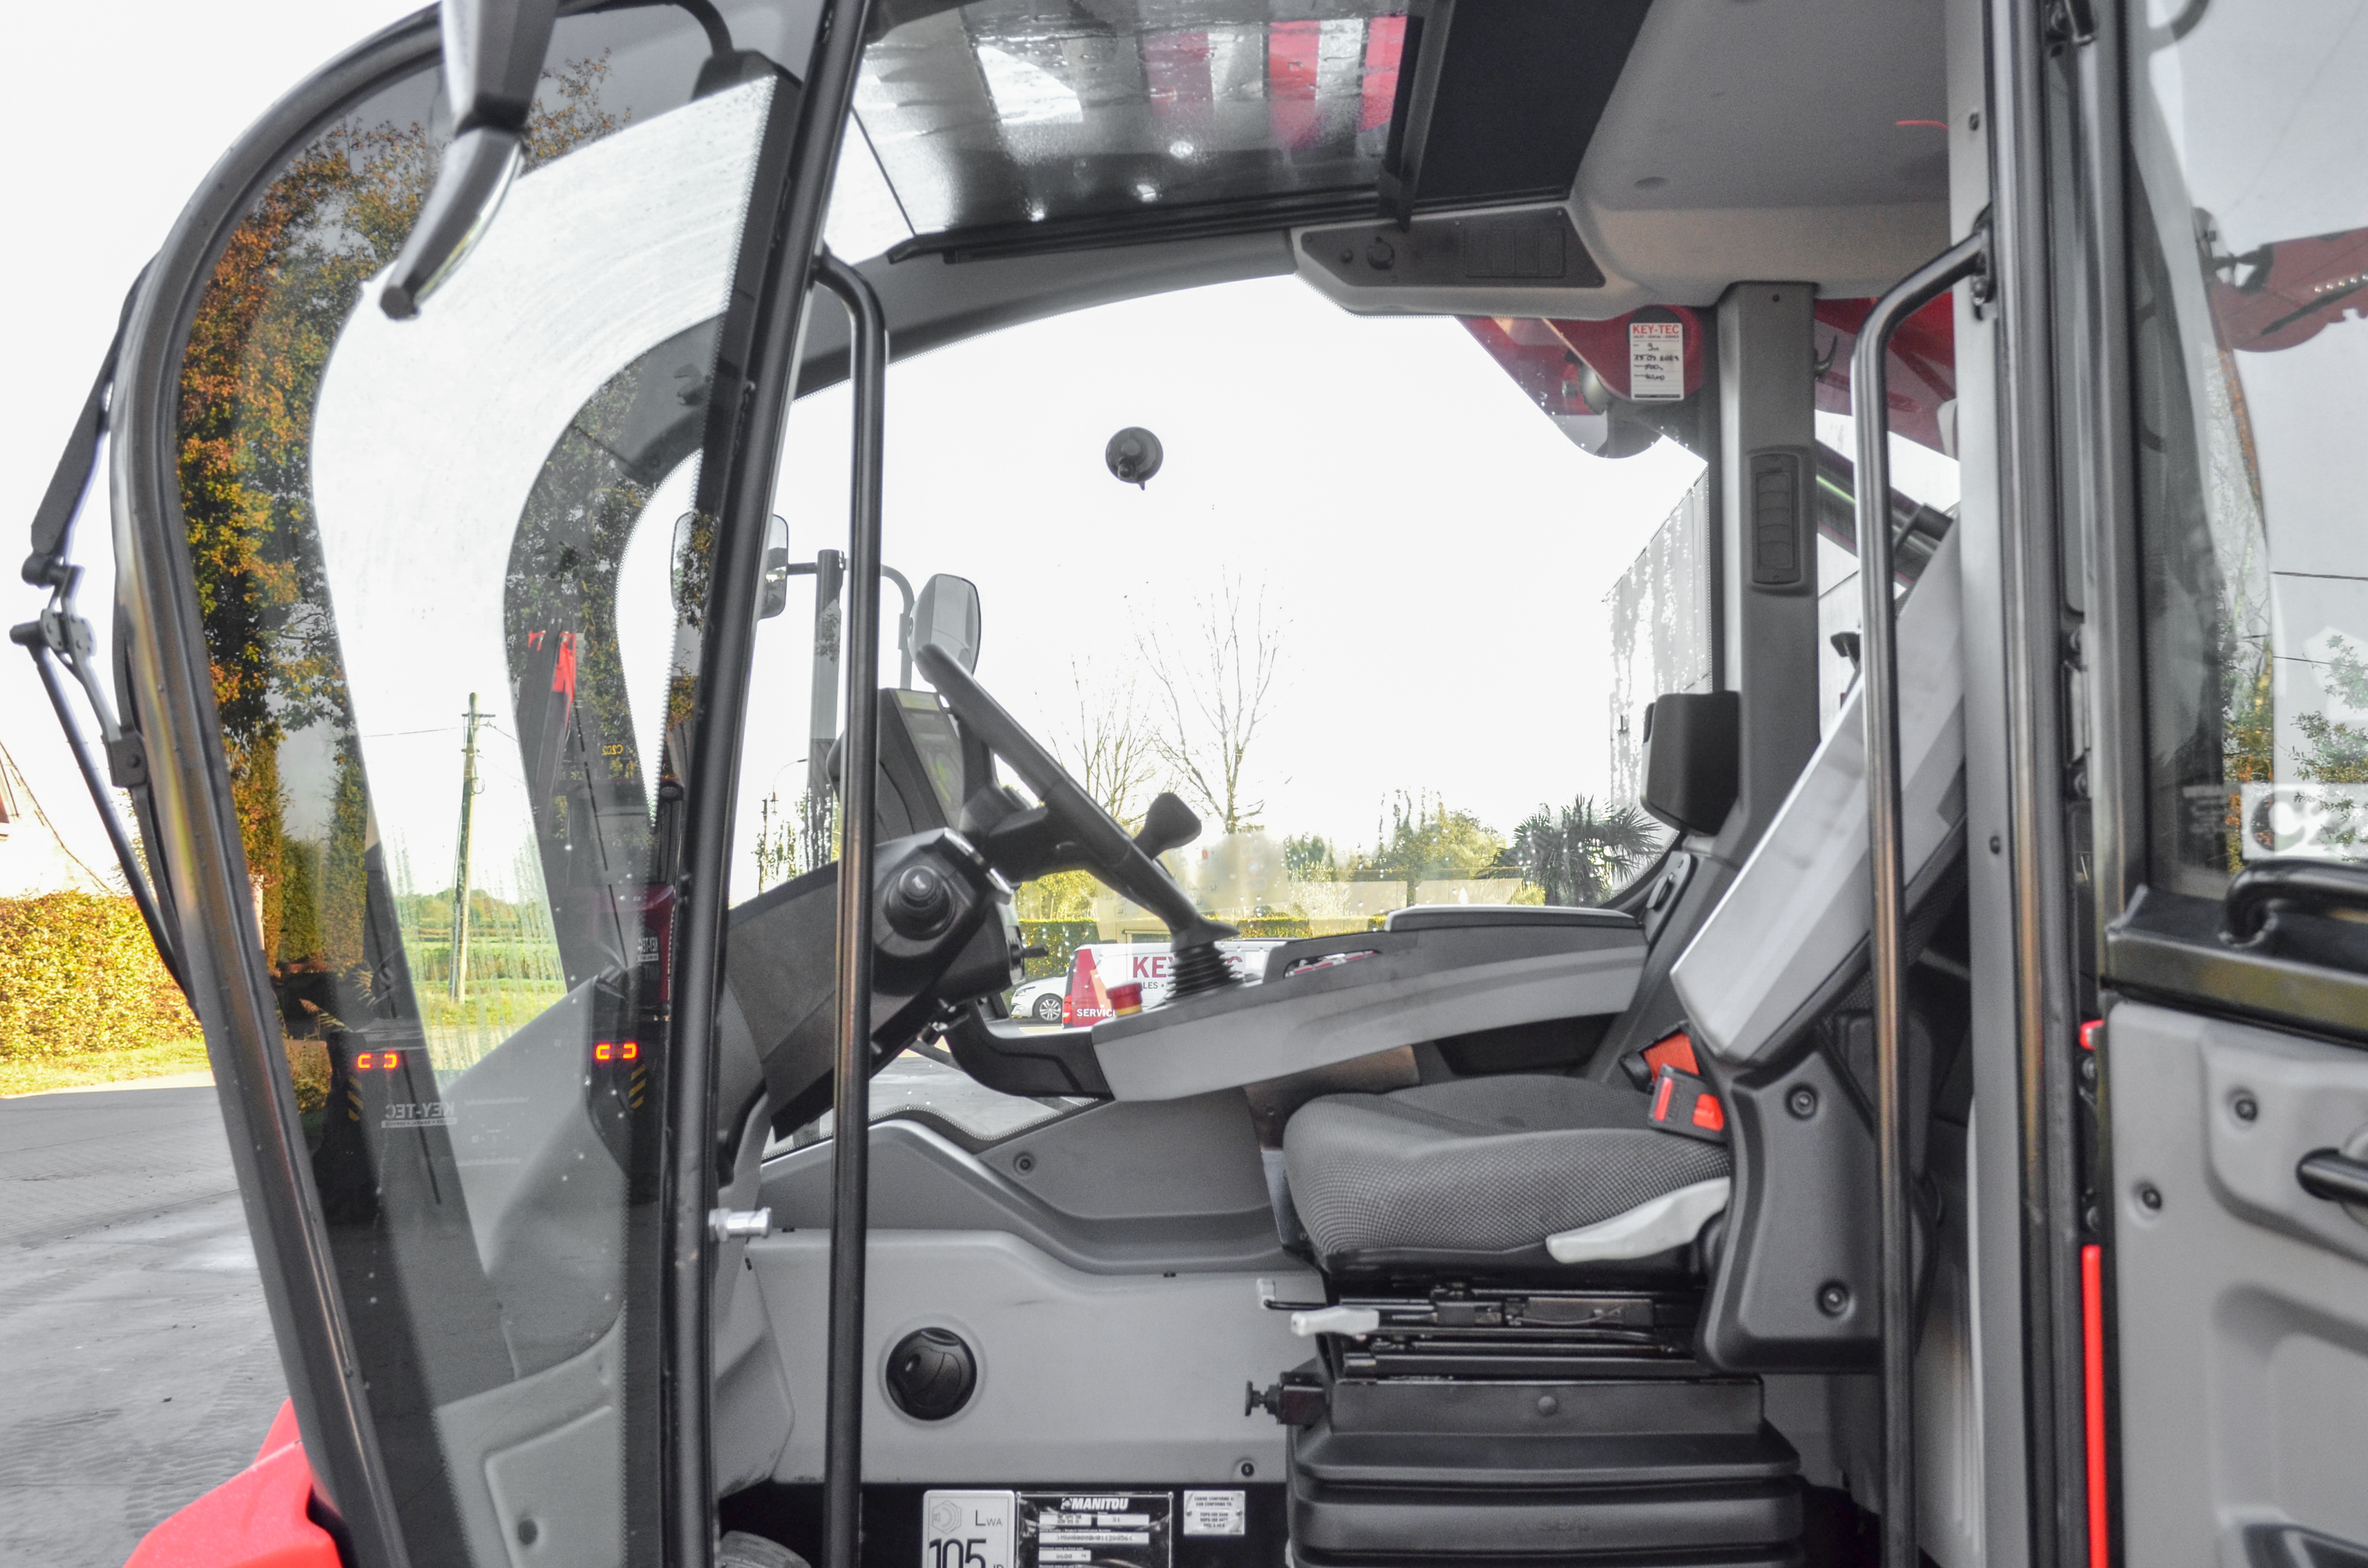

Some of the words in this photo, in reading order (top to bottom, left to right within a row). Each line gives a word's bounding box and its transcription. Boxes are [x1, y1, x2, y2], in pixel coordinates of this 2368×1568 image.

[1632, 325, 1679, 334] KEY-TEC
[1071, 1498, 1129, 1511] MANITOU
[929, 1538, 987, 1568] 105
